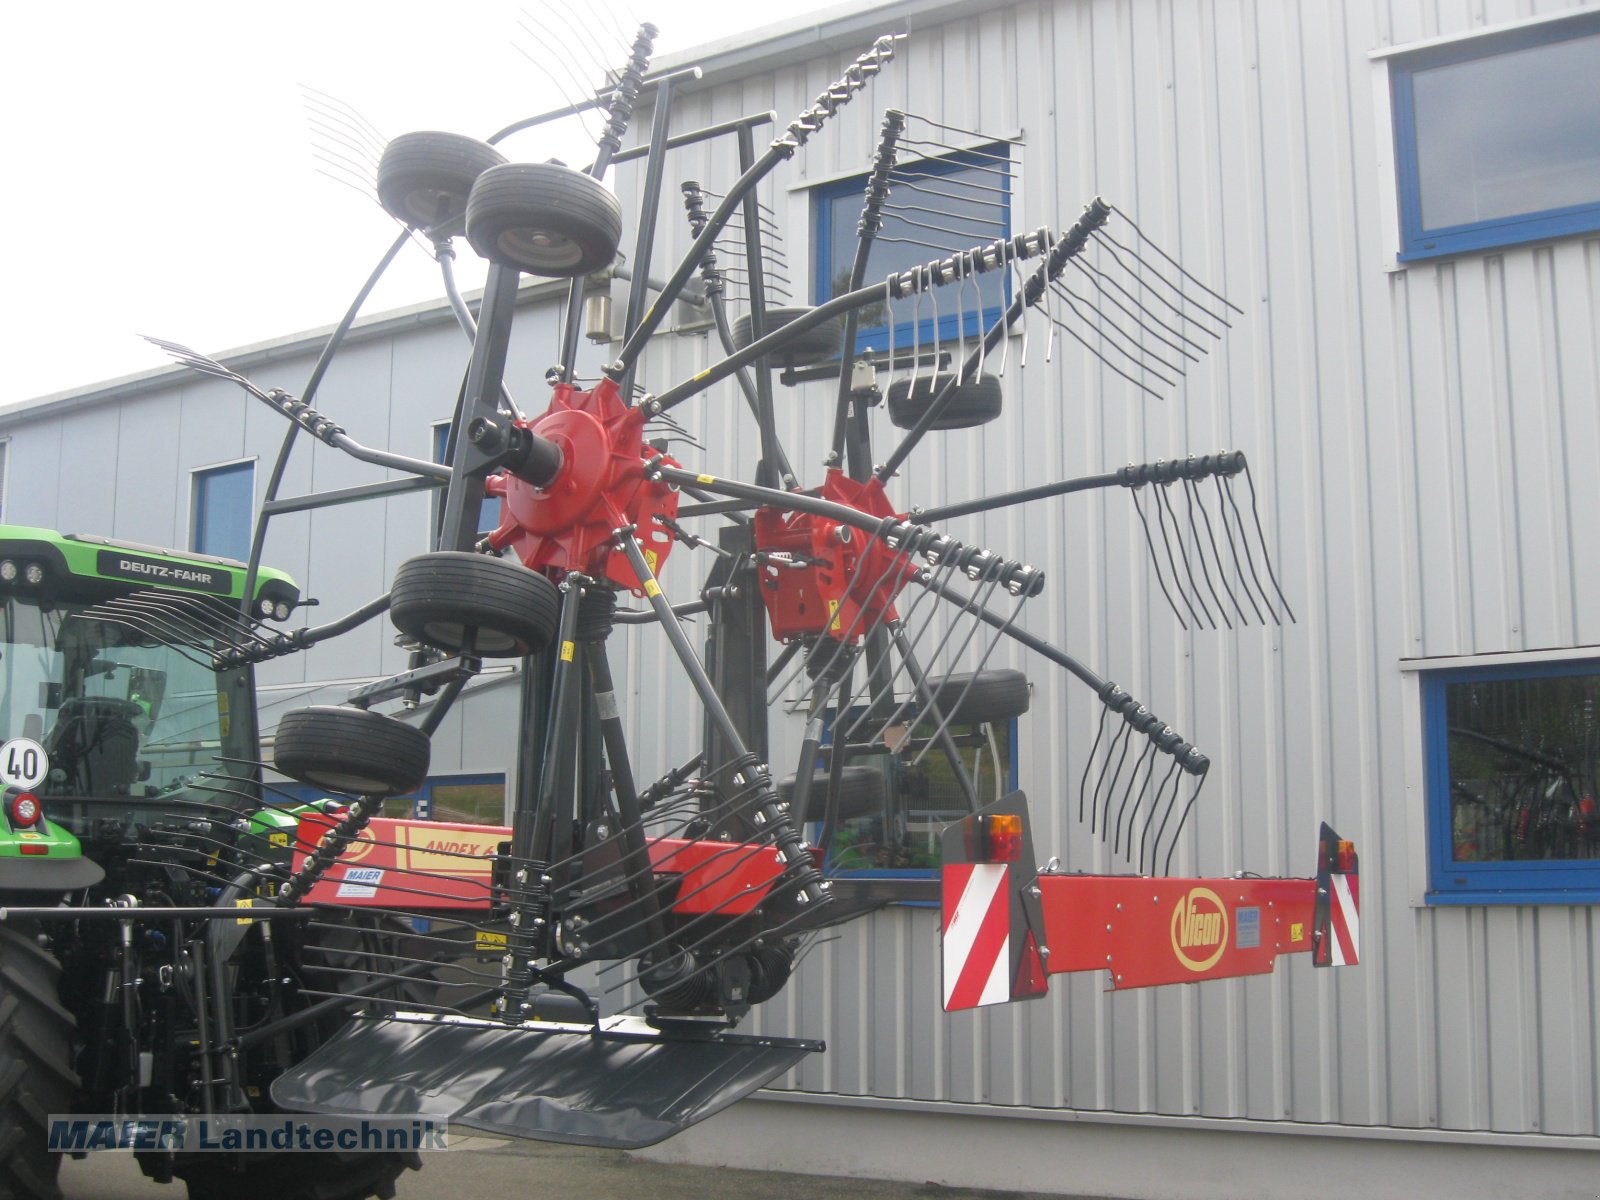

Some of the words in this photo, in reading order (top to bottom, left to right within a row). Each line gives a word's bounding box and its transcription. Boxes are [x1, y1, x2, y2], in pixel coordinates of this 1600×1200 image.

[120, 559, 212, 584] DEUTZ-FAHR
[7, 747, 38, 780] 40
[422, 840, 480, 856] ANDEX
[346, 870, 381, 880] MAIER
[1177, 895, 1222, 948] Vicon
